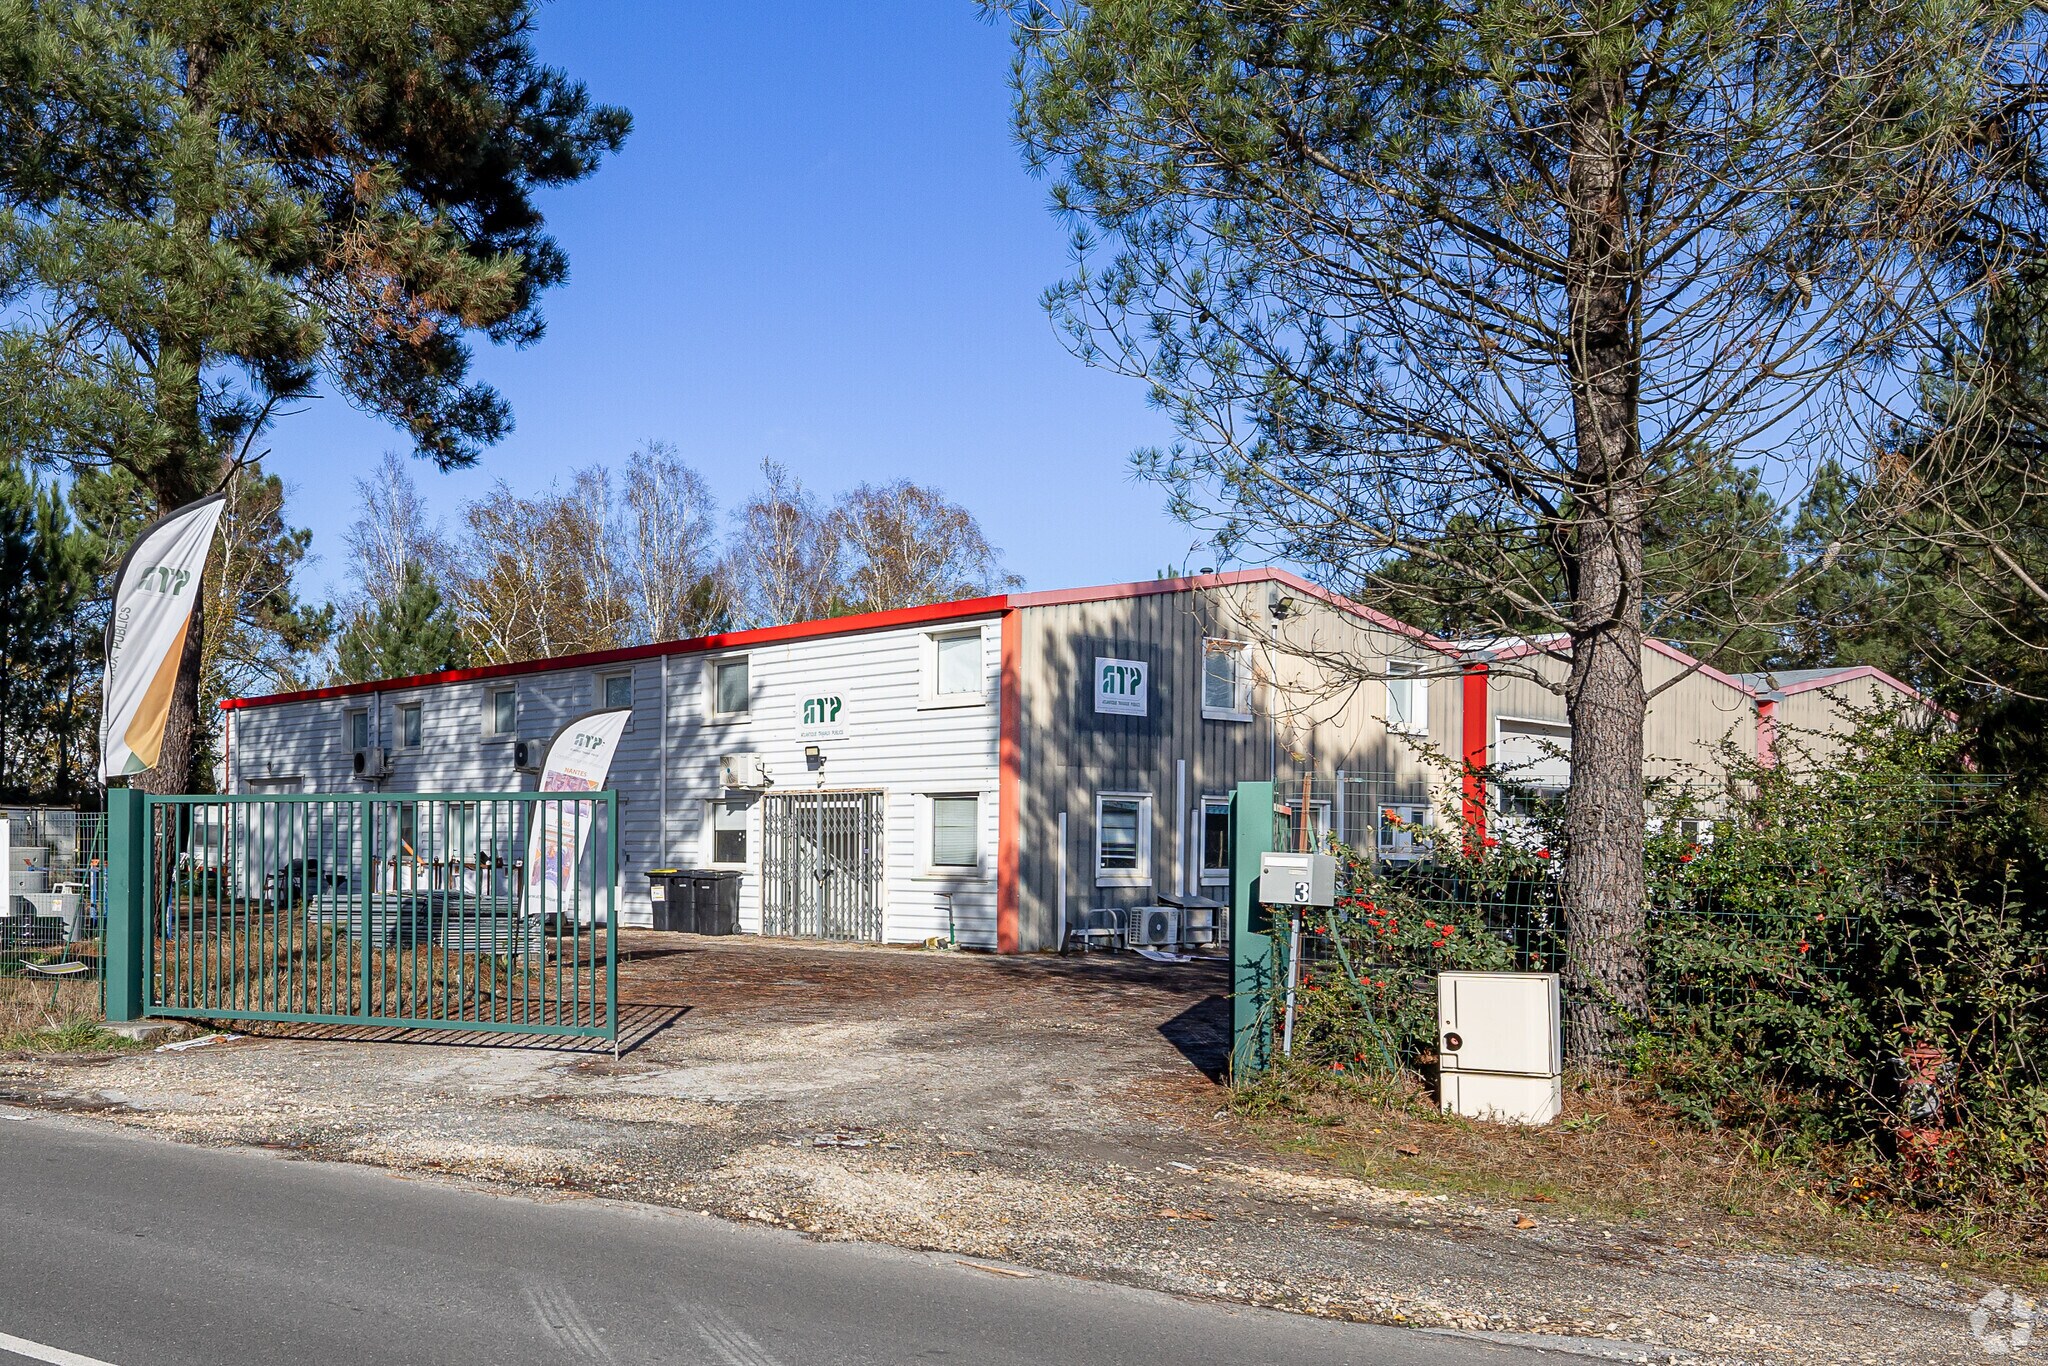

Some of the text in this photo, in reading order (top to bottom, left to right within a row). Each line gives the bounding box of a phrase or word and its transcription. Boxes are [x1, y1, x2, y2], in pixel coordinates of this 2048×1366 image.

[138, 566, 191, 596] ATP
[1103, 665, 1142, 696] ATP
[803, 696, 842, 724] ATP
[564, 767, 588, 777] NANTES
[1295, 882, 1309, 902] 3
